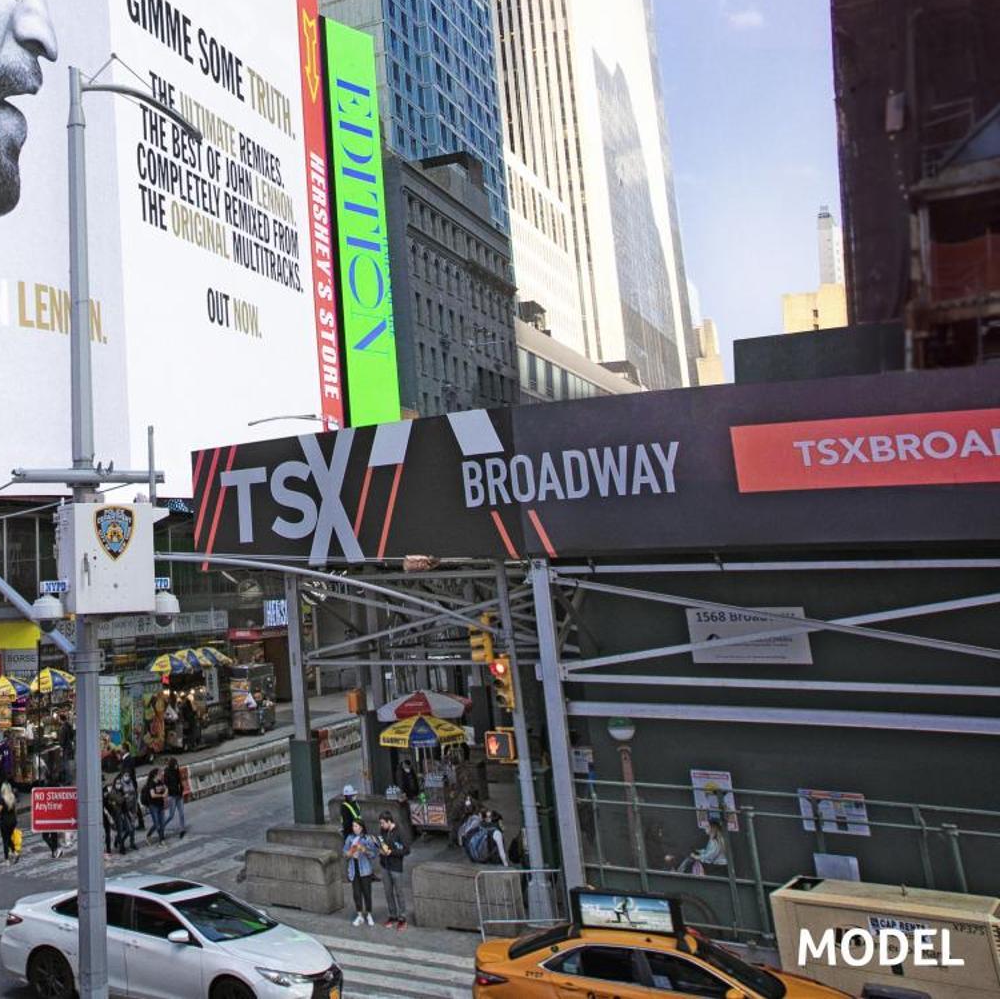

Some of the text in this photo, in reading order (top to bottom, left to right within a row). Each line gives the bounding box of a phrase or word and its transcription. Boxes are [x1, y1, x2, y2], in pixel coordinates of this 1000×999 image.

[149, 70, 176, 109] THE
[239, 132, 285, 188] REMIXES.
[198, 27, 245, 102] SOME
[247, 66, 296, 140] TRUTH.
[137, 142, 300, 260] COMPLETELY REMIXED FROM
[139, 103, 297, 226] THE BEST OF JOHN LENNON.
[138, 183, 304, 294] THE ORIGINAL MULTITRACKS.
[309, 150, 333, 301] HERSHEY'S
[336, 78, 389, 355] EDITION
[18, 280, 107, 345] LENNN.
[207, 287, 262, 338] OUT NOW.
[319, 307, 341, 400] STORE
[220, 428, 366, 567] TSX
[462, 441, 679, 509] BROADWAY
[793, 426, 1000, 469] TSXBROA
[45, 582, 67, 592] NYPD
[696, 611, 727, 623] 1568
[35, 791, 45, 801] NO
[35, 801, 63, 812] Anytime
